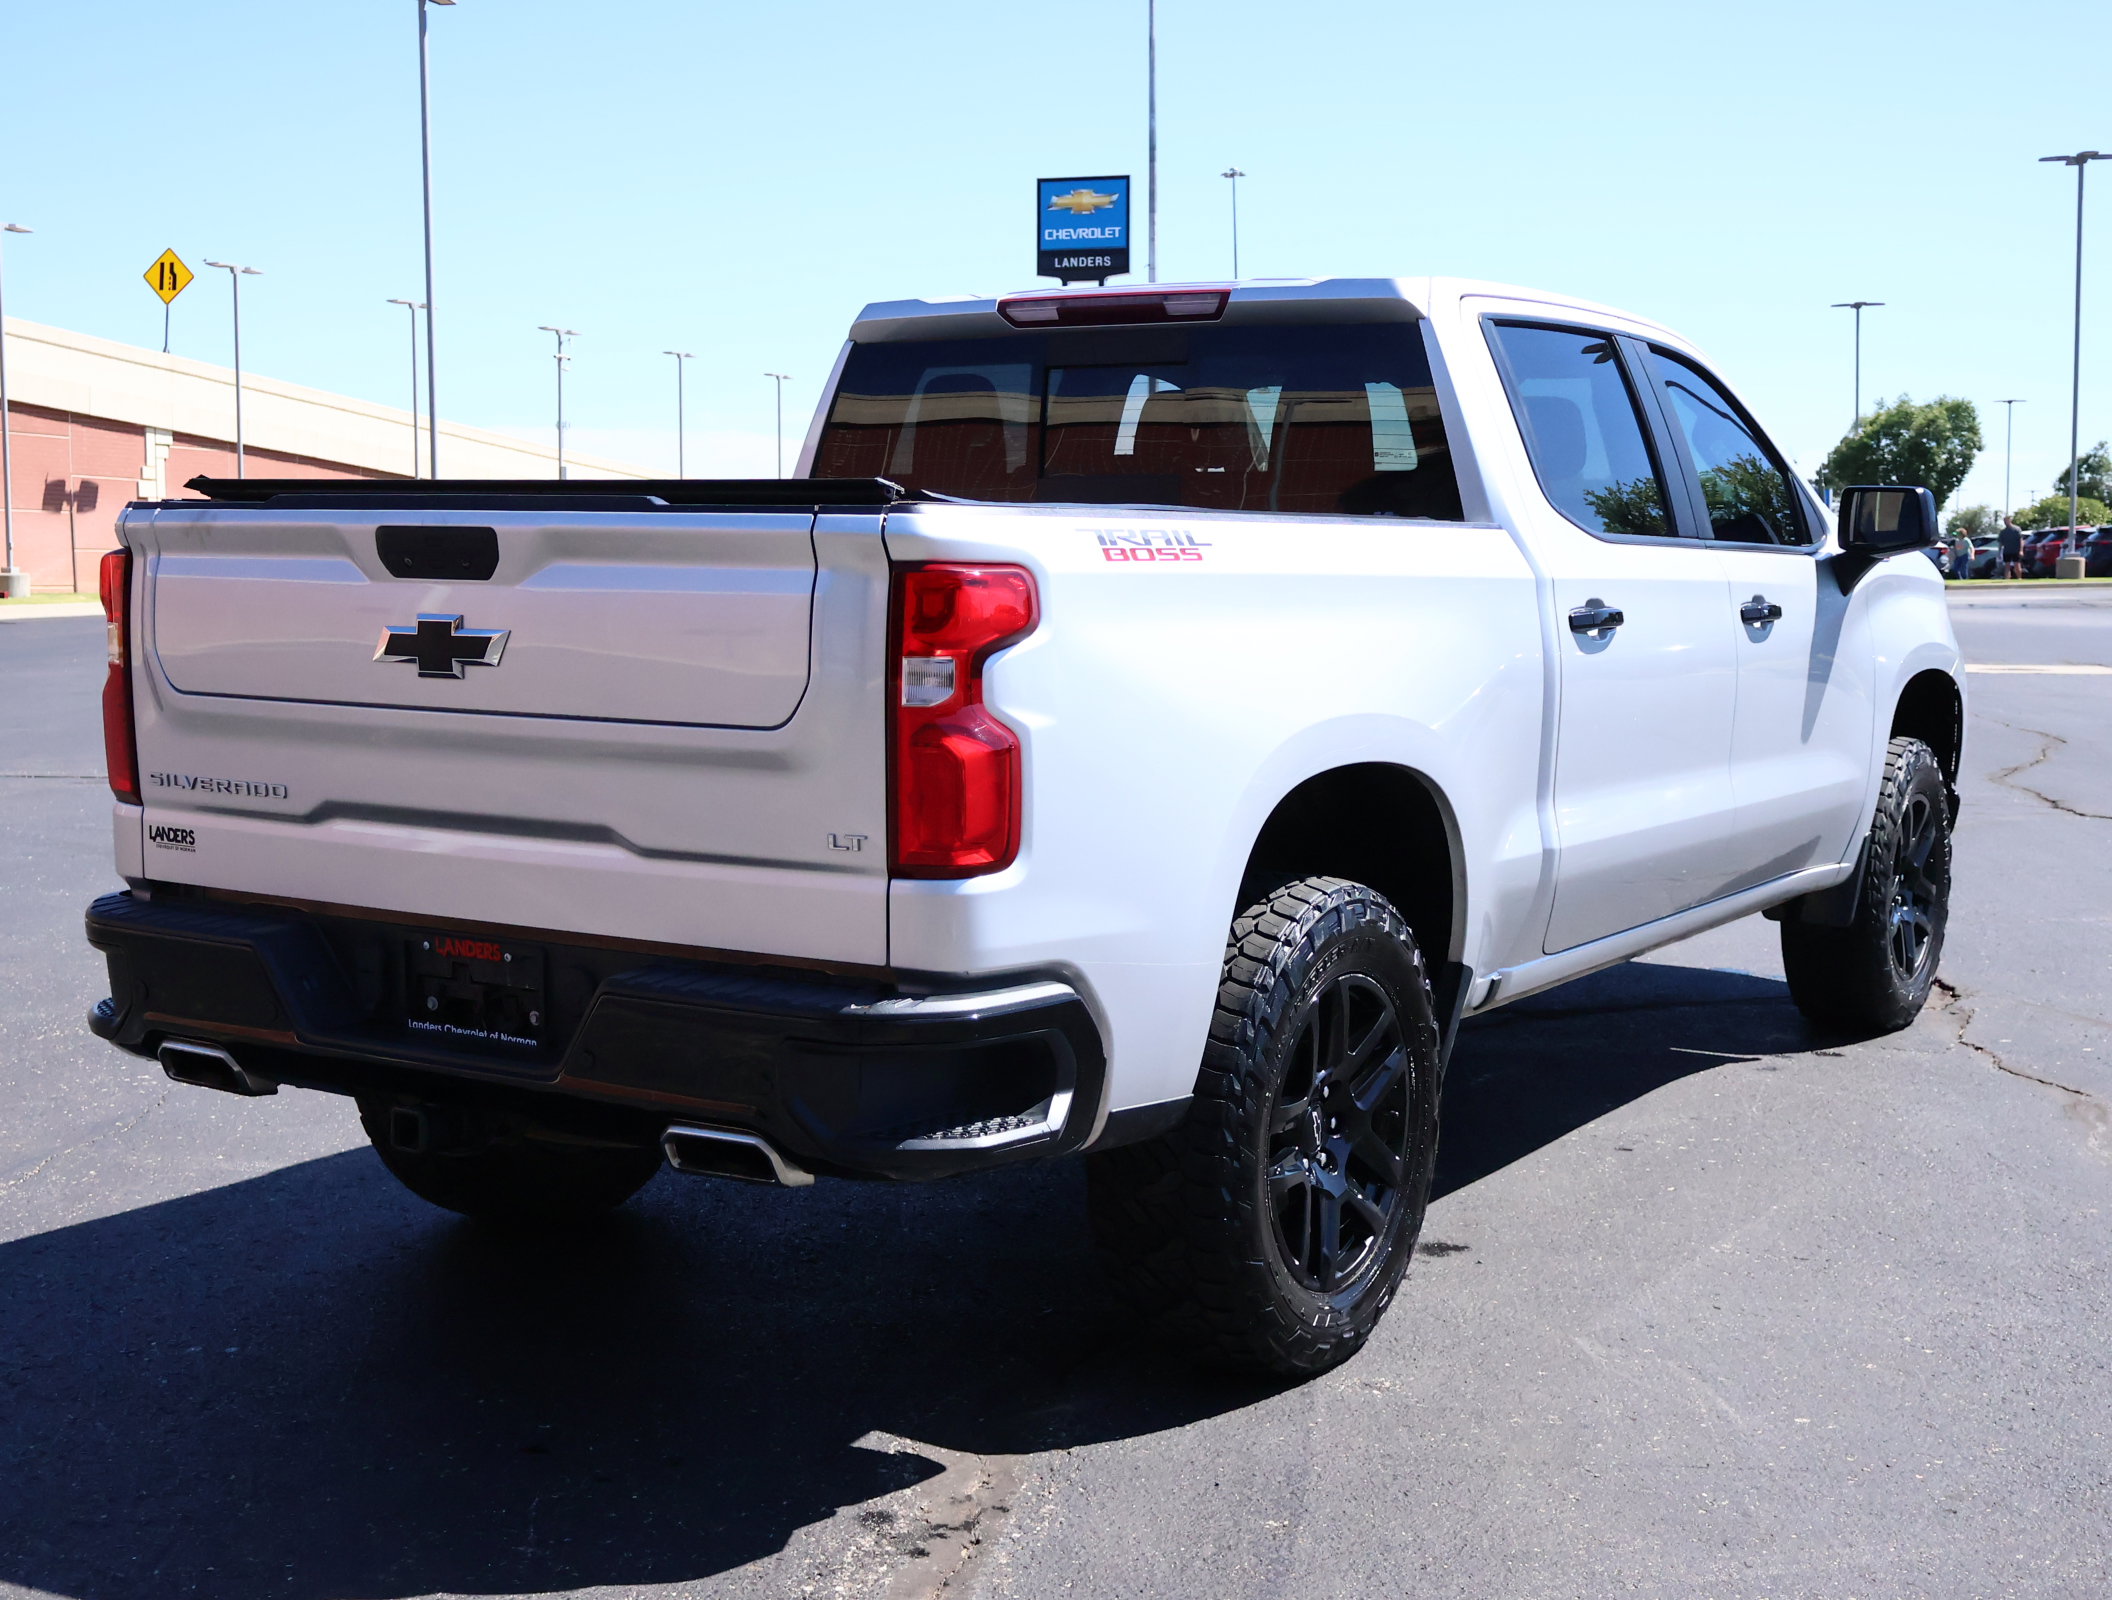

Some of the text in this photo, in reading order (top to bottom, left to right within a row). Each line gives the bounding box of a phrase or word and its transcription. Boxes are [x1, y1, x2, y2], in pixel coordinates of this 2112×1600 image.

[1044, 227, 1121, 240] CHEVROLET
[1054, 256, 1112, 268] LANDERS
[1075, 529, 1213, 546] TRAIL
[1102, 548, 1203, 561] BOSS
[150, 772, 288, 799] SILVERADO
[149, 825, 195, 845] LANDERS
[827, 833, 868, 852] LT
[435, 936, 502, 961] LANDERS
[408, 1018, 537, 1046] Landers Chevrolet of Norman
